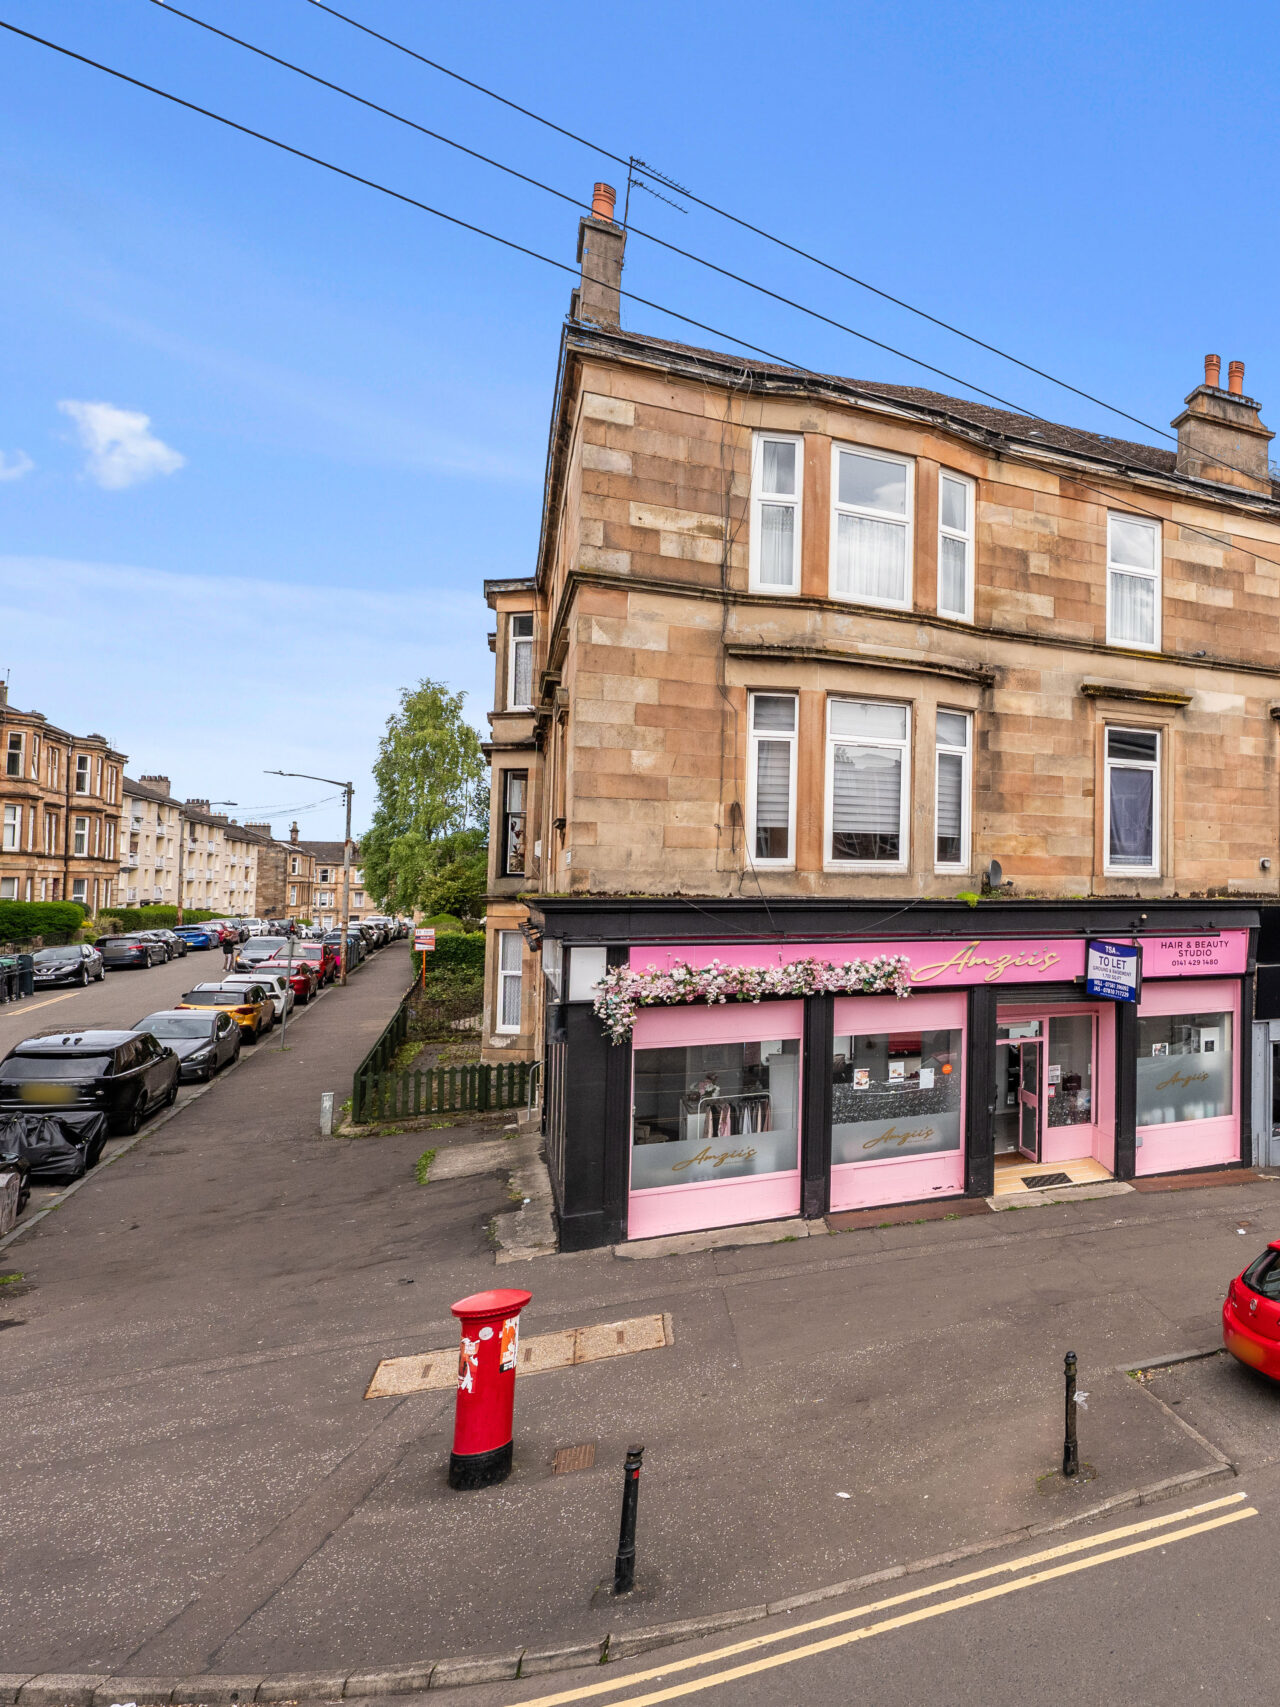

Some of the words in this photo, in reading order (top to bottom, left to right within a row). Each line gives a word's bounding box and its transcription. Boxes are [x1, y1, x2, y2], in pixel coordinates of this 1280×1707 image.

[1160, 941, 1183, 949] HAIR
[1186, 941, 1192, 949] &
[1194, 940, 1230, 949] BEAUTY
[1104, 945, 1116, 954] TSA
[1178, 949, 1212, 957] STUDIO
[1099, 956, 1110, 967] TO
[1111, 958, 1127, 970] LET
[1202, 958, 1219, 966] 1480
